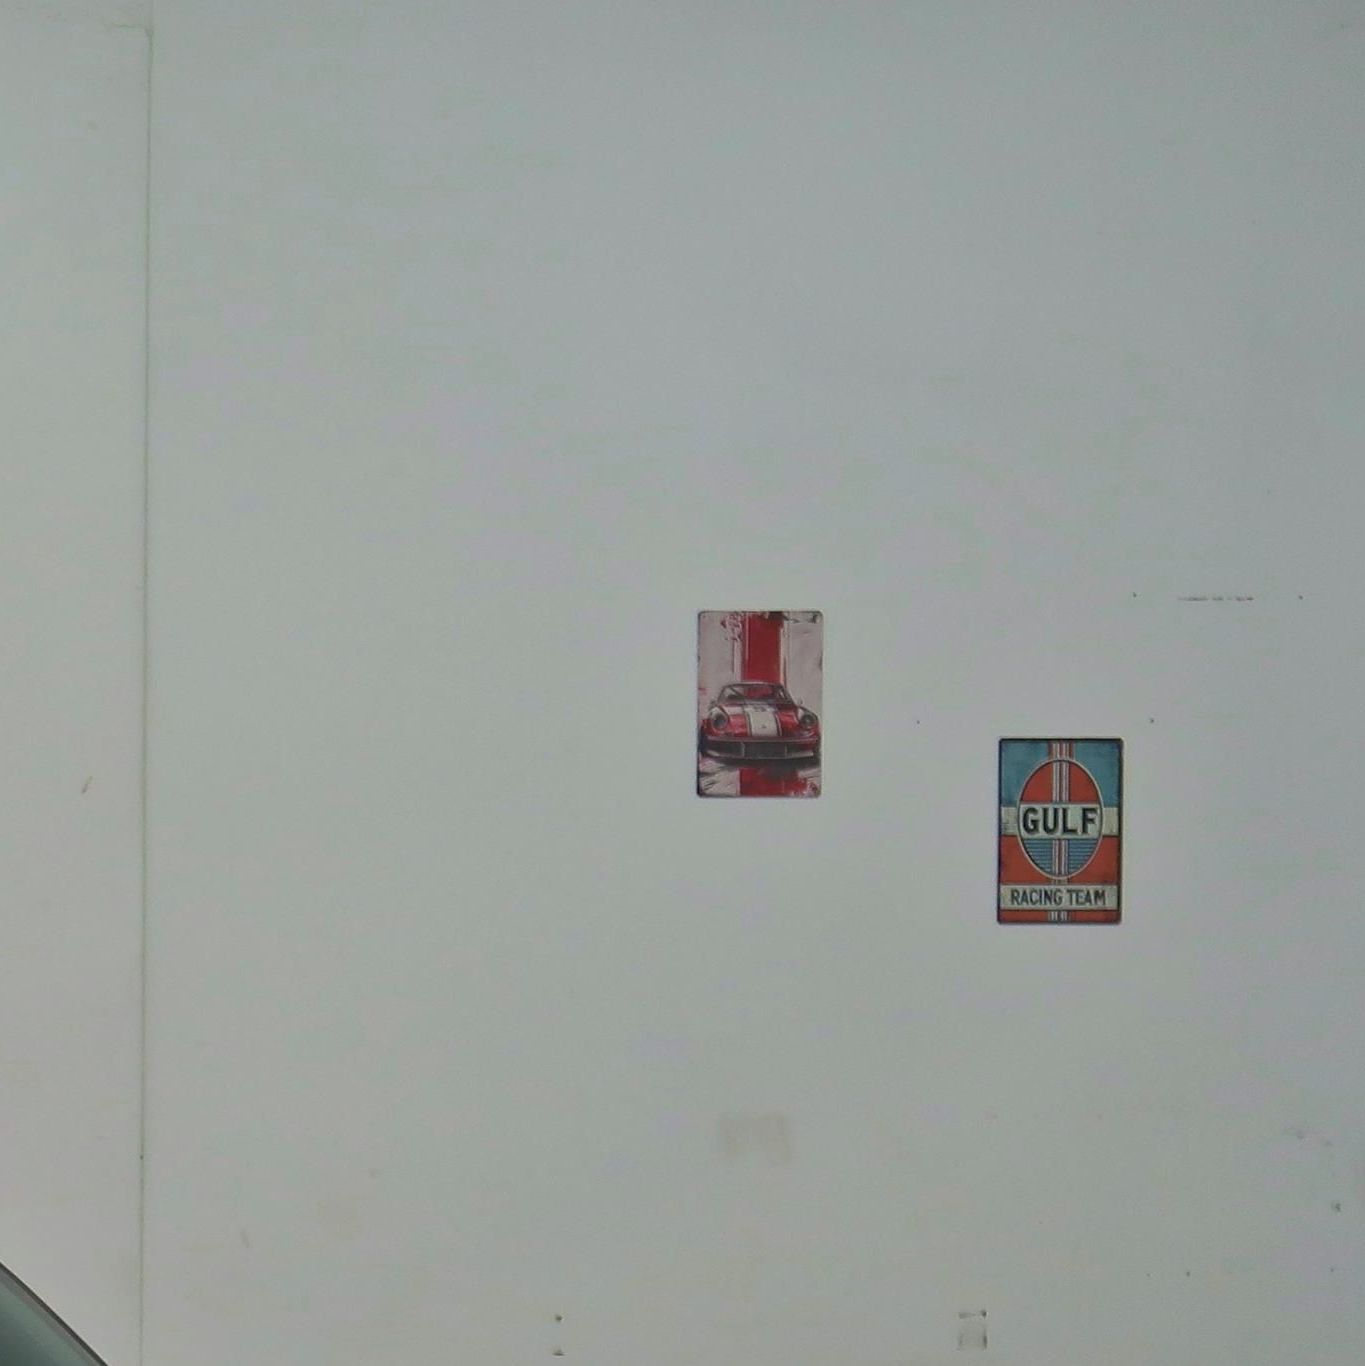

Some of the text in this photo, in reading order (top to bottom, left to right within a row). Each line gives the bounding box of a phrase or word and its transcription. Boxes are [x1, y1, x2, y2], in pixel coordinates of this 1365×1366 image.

[1022, 807, 1098, 836] GULF
[1010, 888, 1107, 907] RACING TEAM
